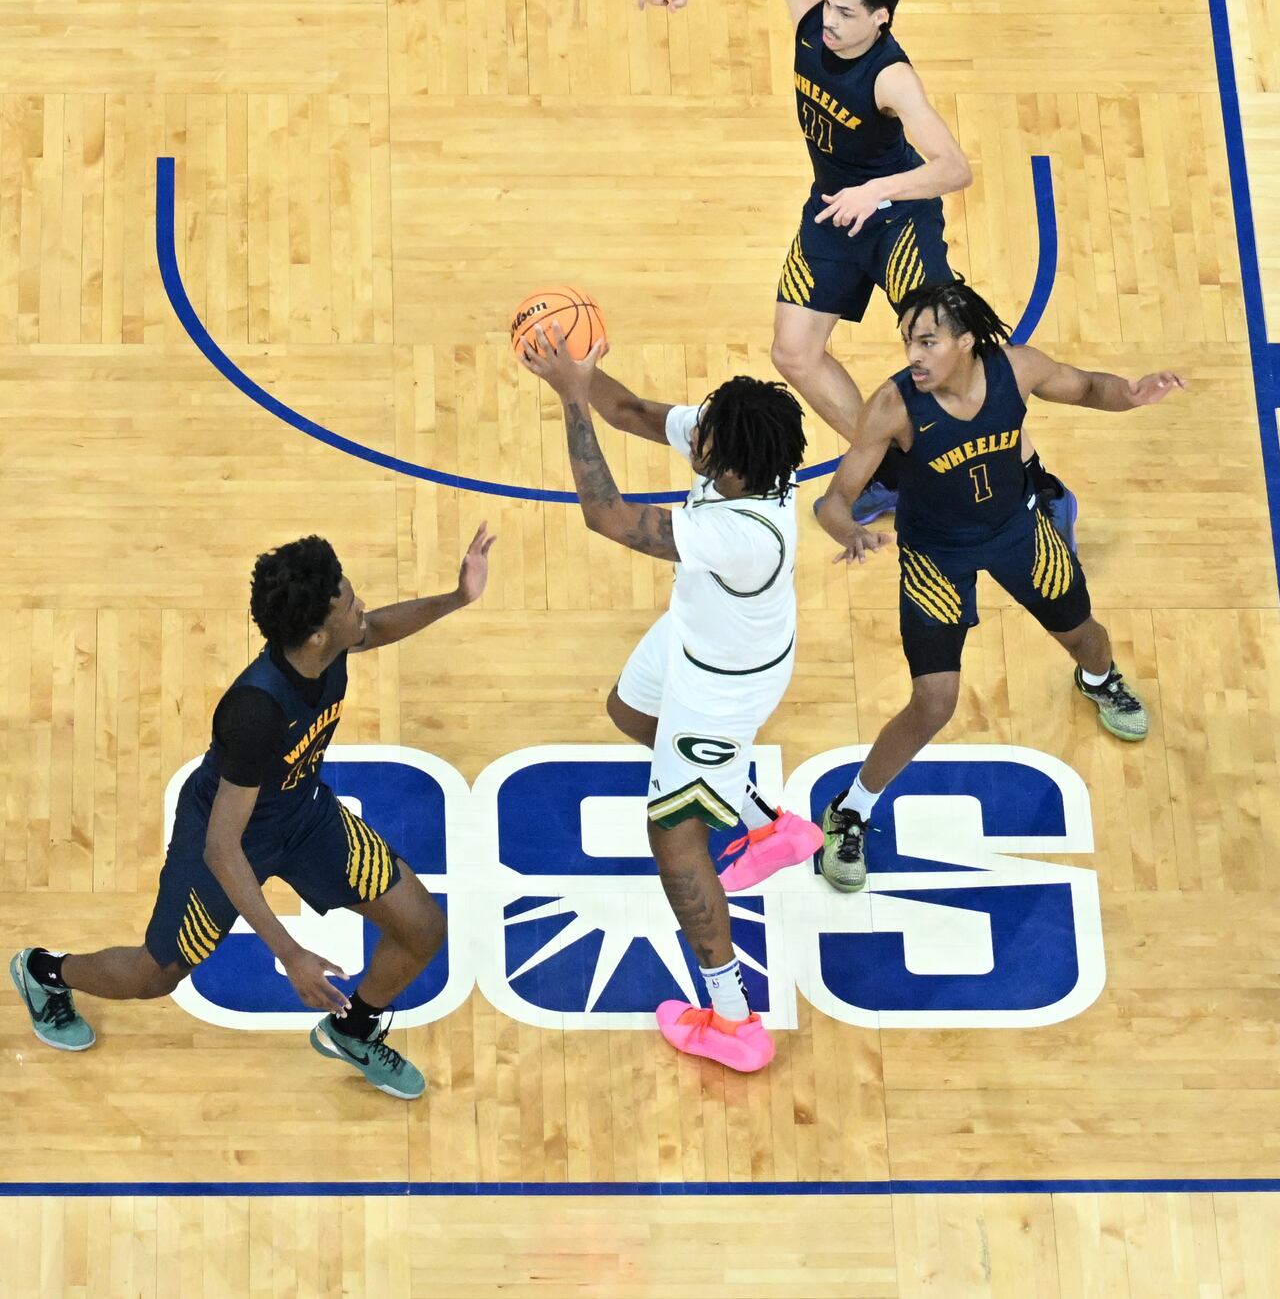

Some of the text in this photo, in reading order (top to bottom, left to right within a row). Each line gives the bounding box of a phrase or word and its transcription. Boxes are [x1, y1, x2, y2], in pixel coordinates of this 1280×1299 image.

[803, 101, 833, 154] 11
[969, 463, 993, 503] 1
[673, 732, 741, 770] G
